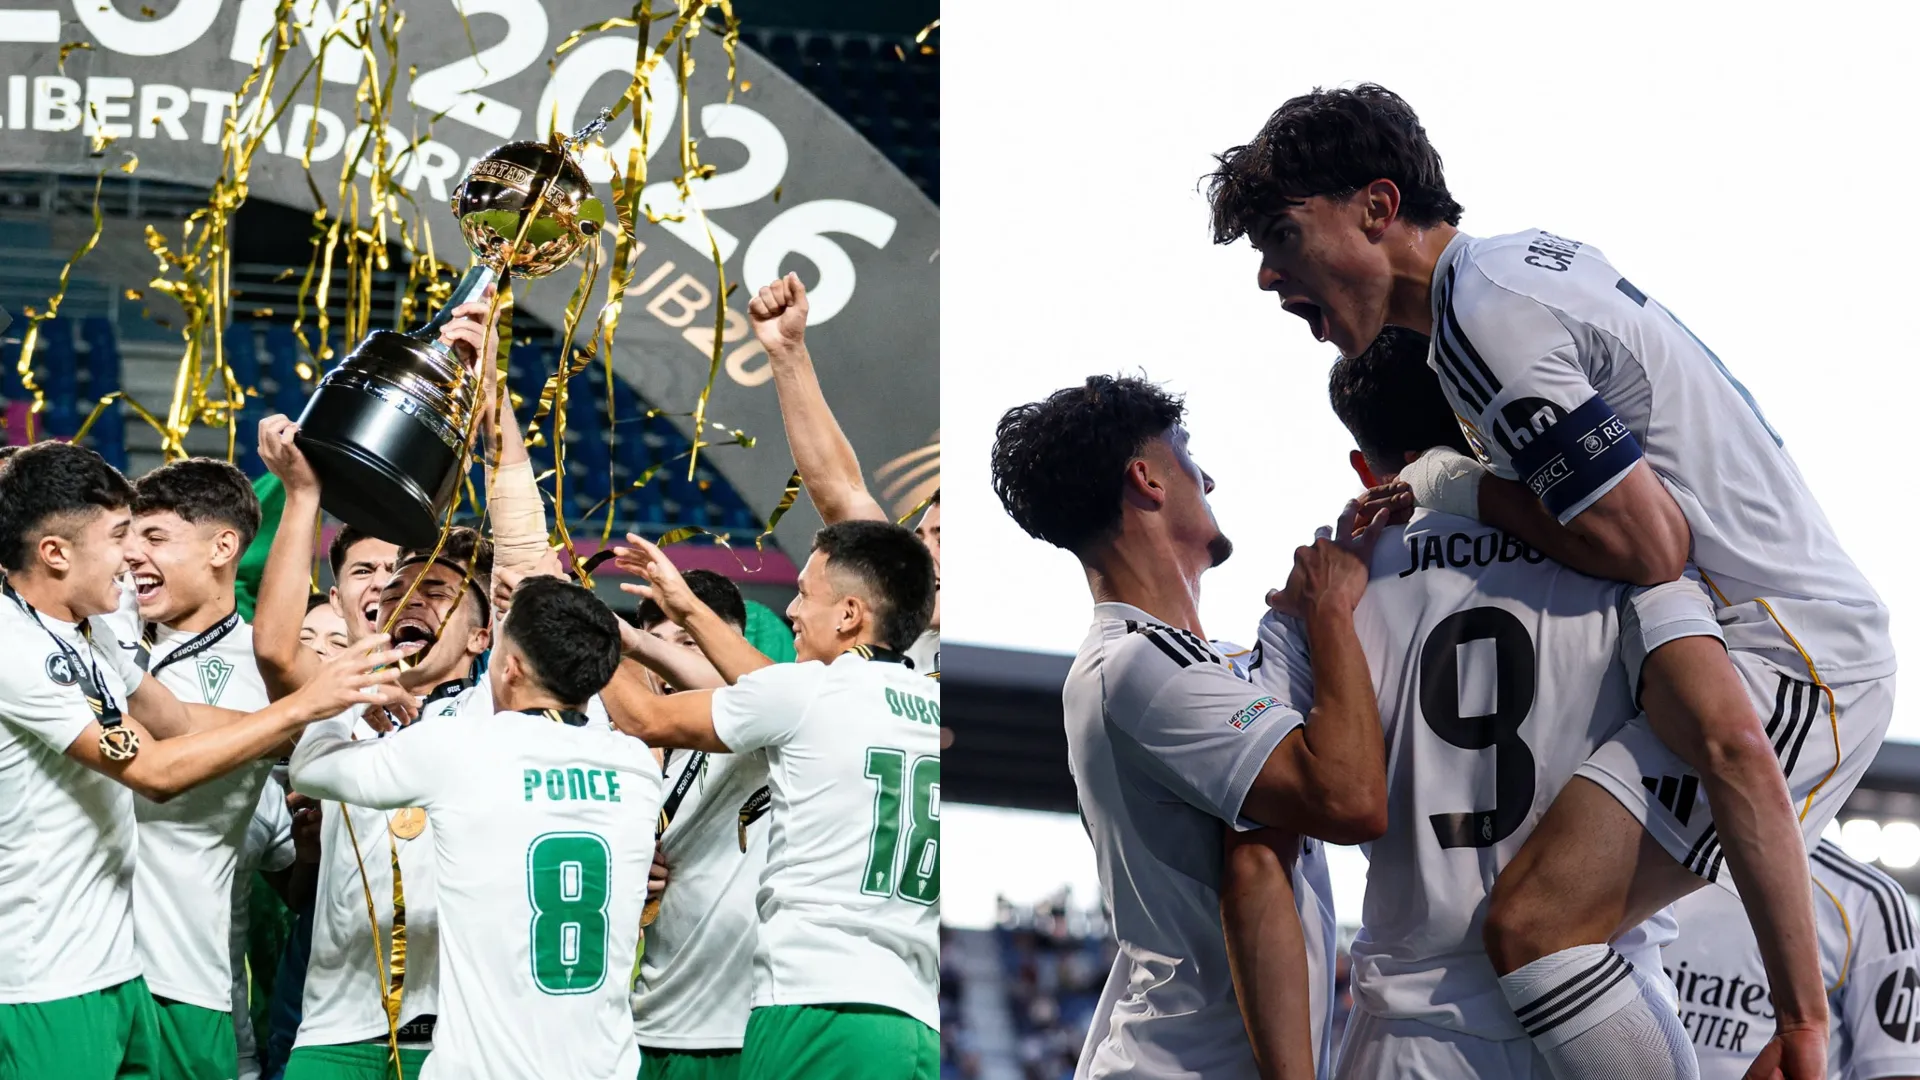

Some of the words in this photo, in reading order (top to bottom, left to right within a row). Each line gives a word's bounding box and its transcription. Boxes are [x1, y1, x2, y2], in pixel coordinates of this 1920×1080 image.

[0, 74, 480, 203] IBERTADOR
[410, 0, 897, 327] 2026
[172, 624, 224, 660] LIBERTADORES
[446, 684, 461, 694] 2026
[1228, 709, 1245, 725] UEFA
[1420, 605, 1536, 850] 9
[523, 767, 621, 803] PONCE
[676, 771, 693, 796] SUB20
[526, 831, 612, 996] 8
[1662, 960, 1776, 1020] irates
[1678, 1009, 1749, 1053] ETTER
